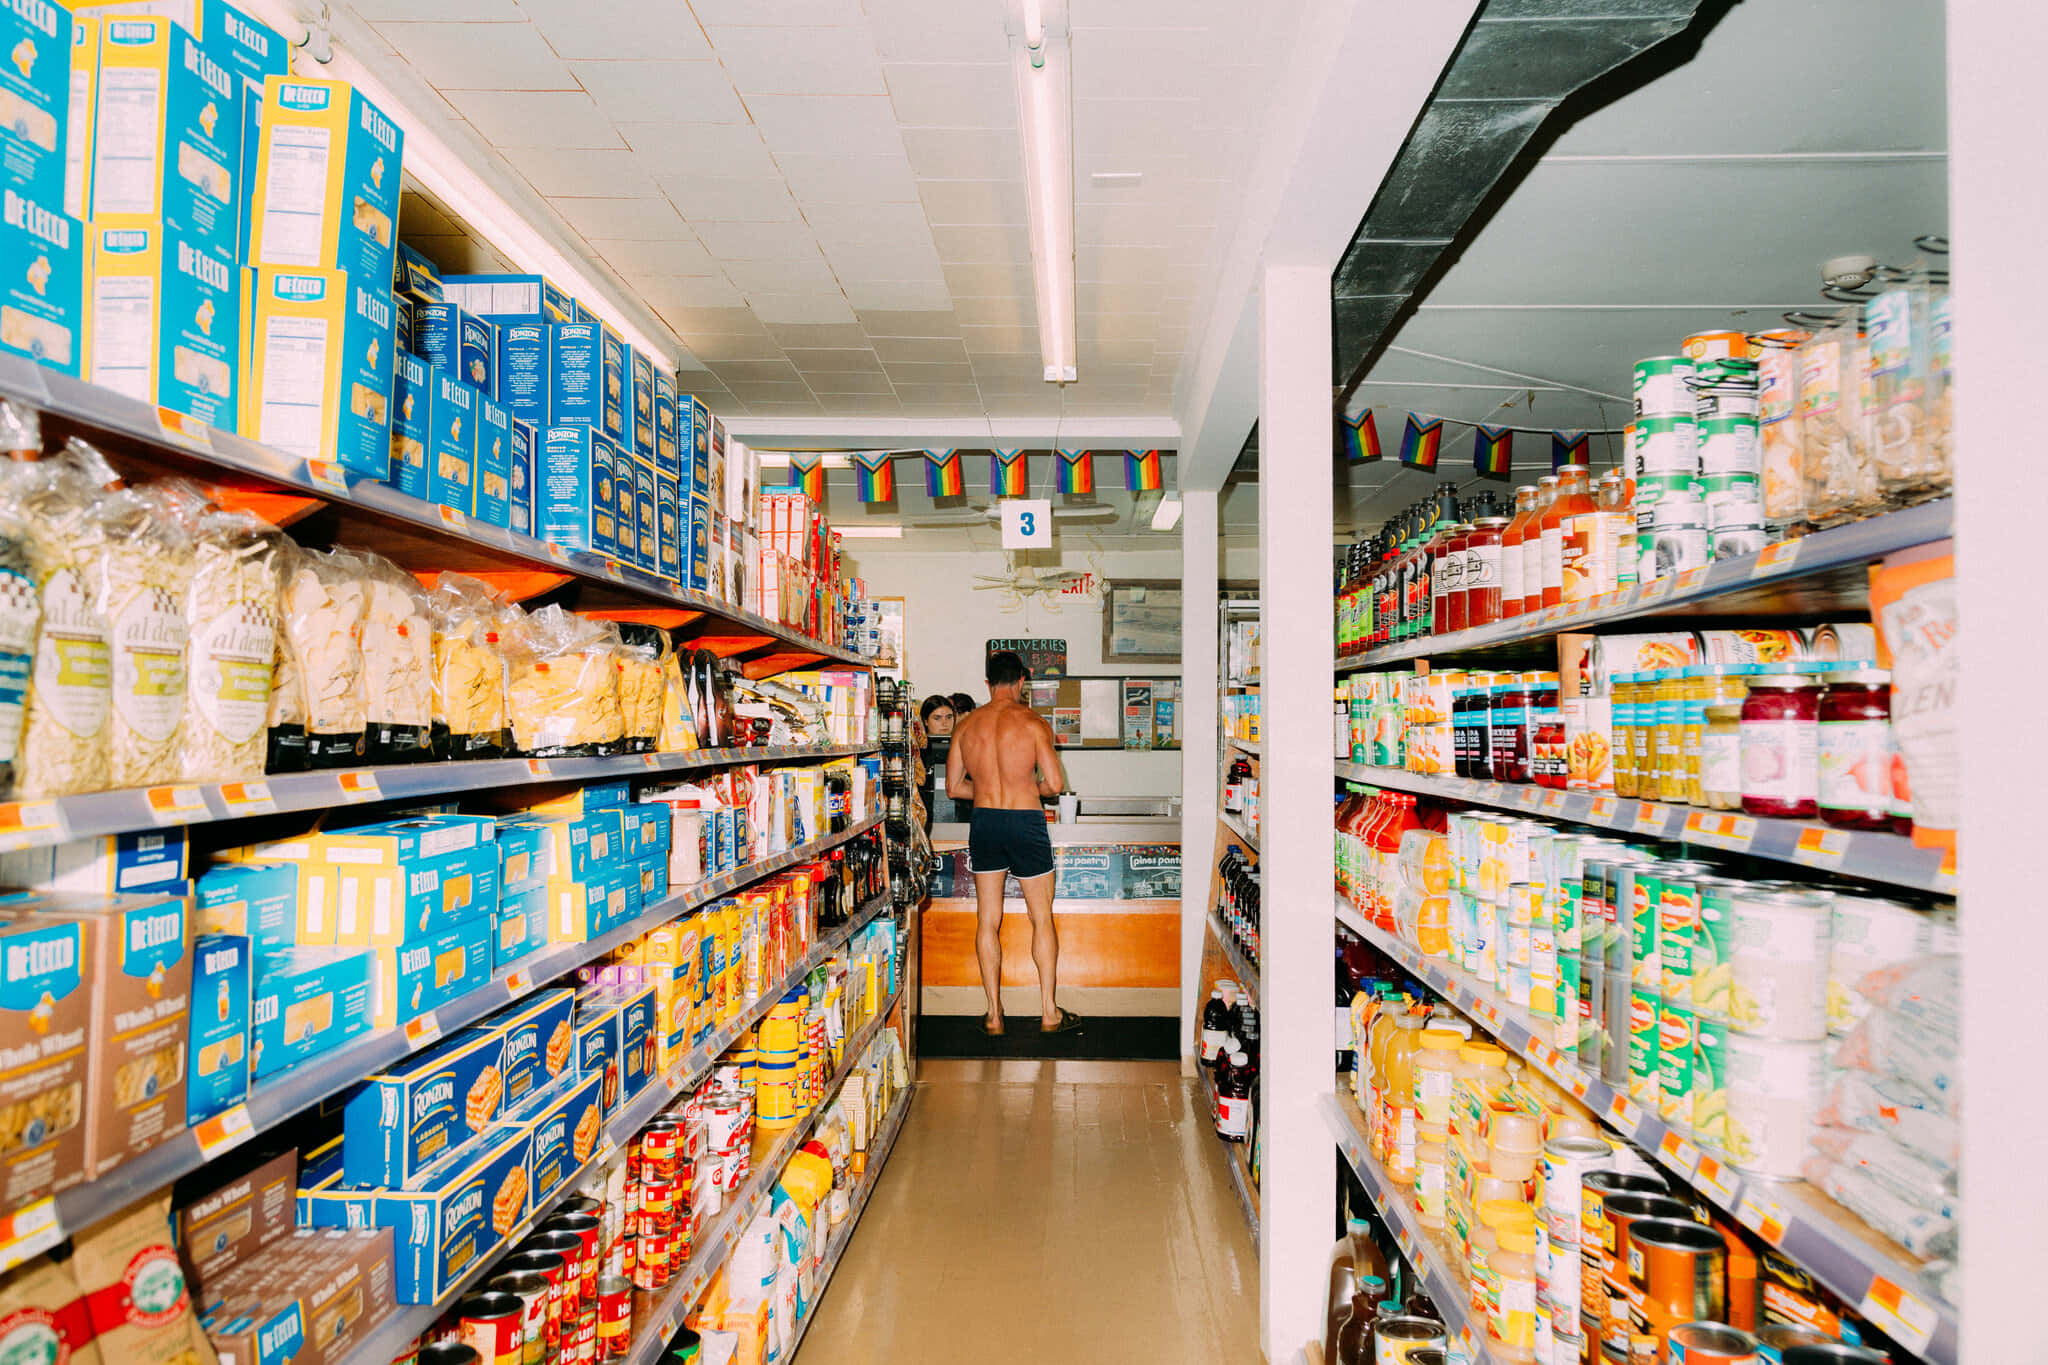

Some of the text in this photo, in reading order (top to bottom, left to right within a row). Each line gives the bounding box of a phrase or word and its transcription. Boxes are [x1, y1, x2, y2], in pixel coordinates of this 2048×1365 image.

[1020, 512, 1036, 536] 3
[991, 640, 1066, 652] DELIVERIES
[1075, 857, 1106, 867] pantry
[1133, 857, 1182, 867] pinos pant
[0, 1043, 41, 1071] hole
[507, 1032, 537, 1066] RONZONI
[414, 1081, 454, 1124] RONZONI
[536, 1122, 565, 1161] RONZONI
[445, 1189, 483, 1240] RONZONI
